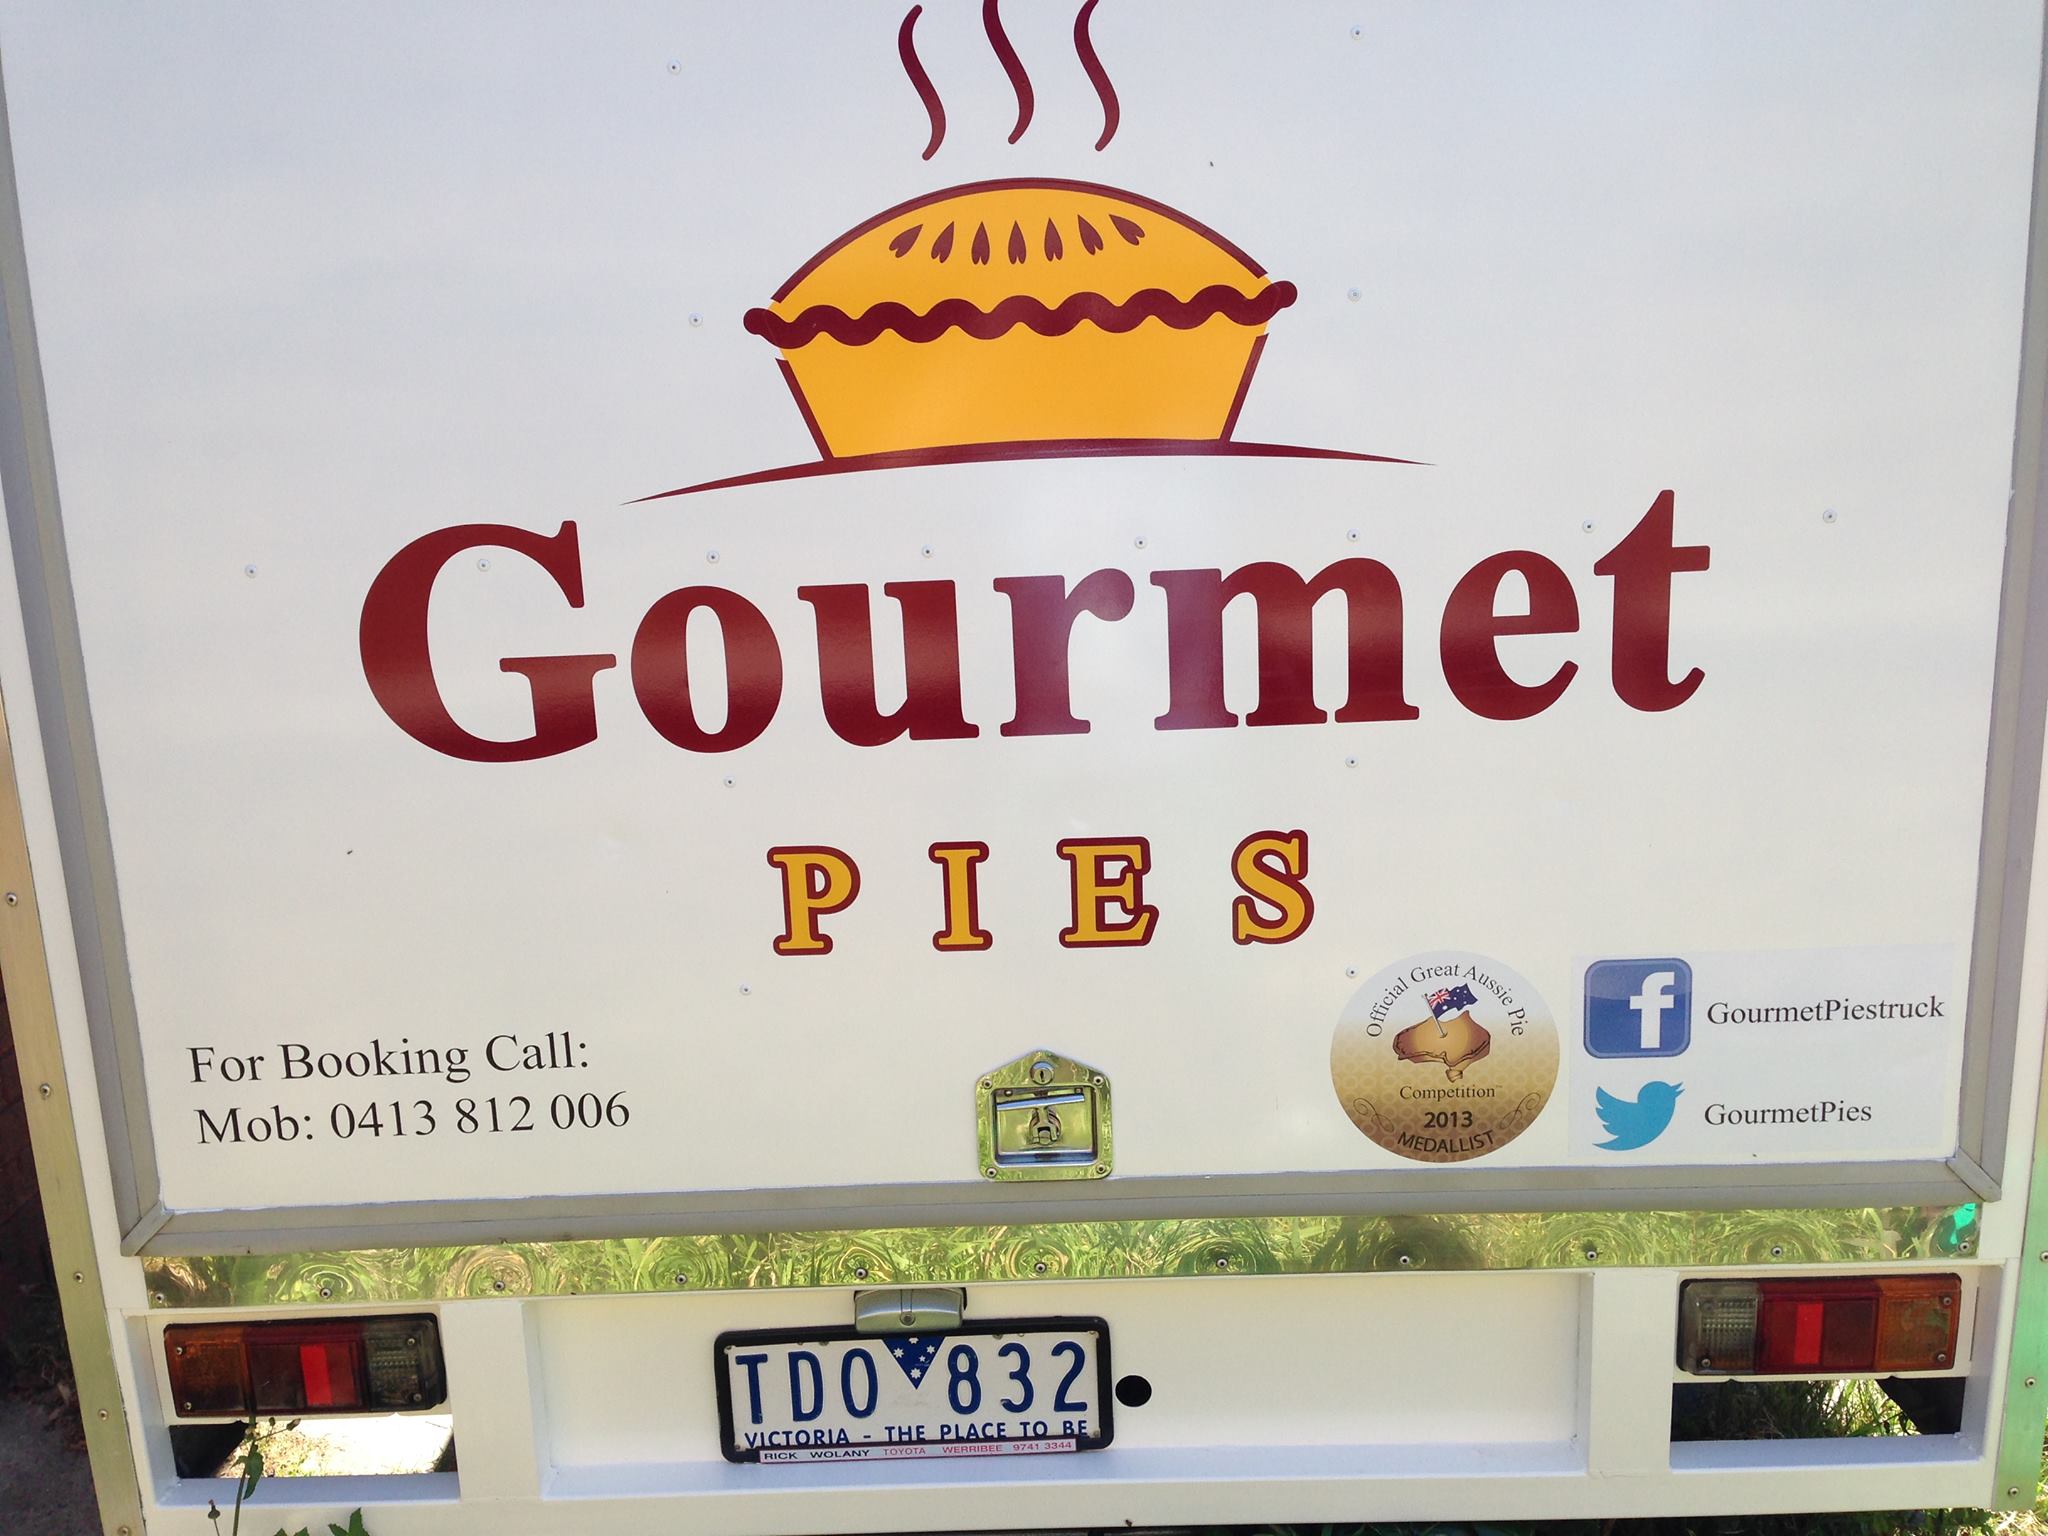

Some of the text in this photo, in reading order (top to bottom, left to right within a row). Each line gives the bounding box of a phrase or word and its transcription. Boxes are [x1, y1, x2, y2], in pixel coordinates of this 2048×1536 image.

[360, 485, 1710, 762] Gourmet
[767, 830, 1314, 956] PIES
[1366, 963, 1528, 1037] Official Great Aussie Pie
[1630, 970, 1675, 1048] f
[1708, 996, 1944, 1026] GourmetPiestruck
[187, 1031, 588, 1084] For Booking Call:
[1400, 1085, 1496, 1102] Competition
[1704, 1101, 1872, 1126] GourmetPies
[194, 1091, 630, 1144] Mob: 0413 812 006
[1423, 1111, 1473, 1129] 2013
[1397, 1130, 1495, 1154] MEDALLIST
[947, 1340, 1088, 1416] 832
[745, 1427, 850, 1449] VICTORIA
[884, 1424, 926, 1442] THE
[940, 1422, 1007, 1440] PLACE
[1020, 1420, 1048, 1438] TO
[1062, 1419, 1088, 1437] BE
[764, 1441, 1072, 1460] RICK WOLANY TOYOTA WERRIBEE 9741 3344
